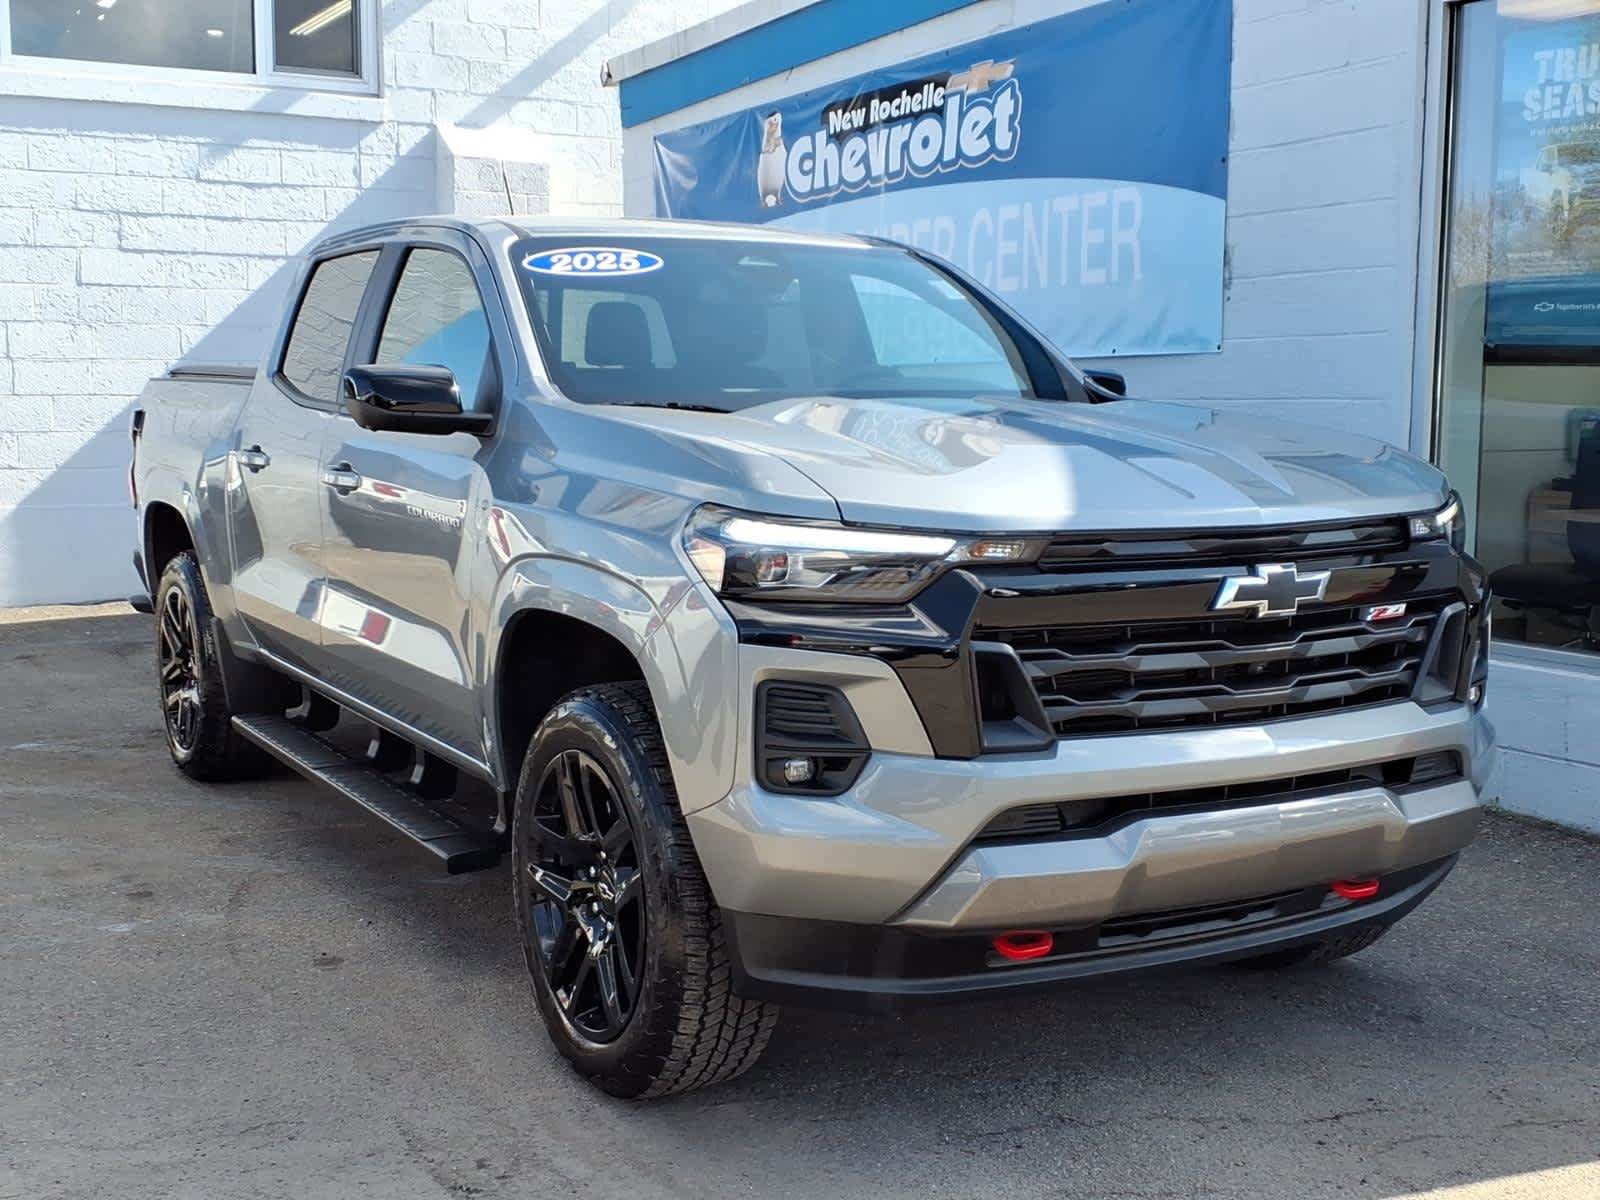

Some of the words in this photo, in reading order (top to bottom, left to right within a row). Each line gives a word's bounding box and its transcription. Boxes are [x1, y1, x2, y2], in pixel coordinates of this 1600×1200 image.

[787, 87, 1015, 194] Chevrolet
[829, 108, 866, 135] New
[870, 83, 945, 124] Rochelle
[550, 252, 641, 273] 2025
[968, 186, 1143, 291] CENTER
